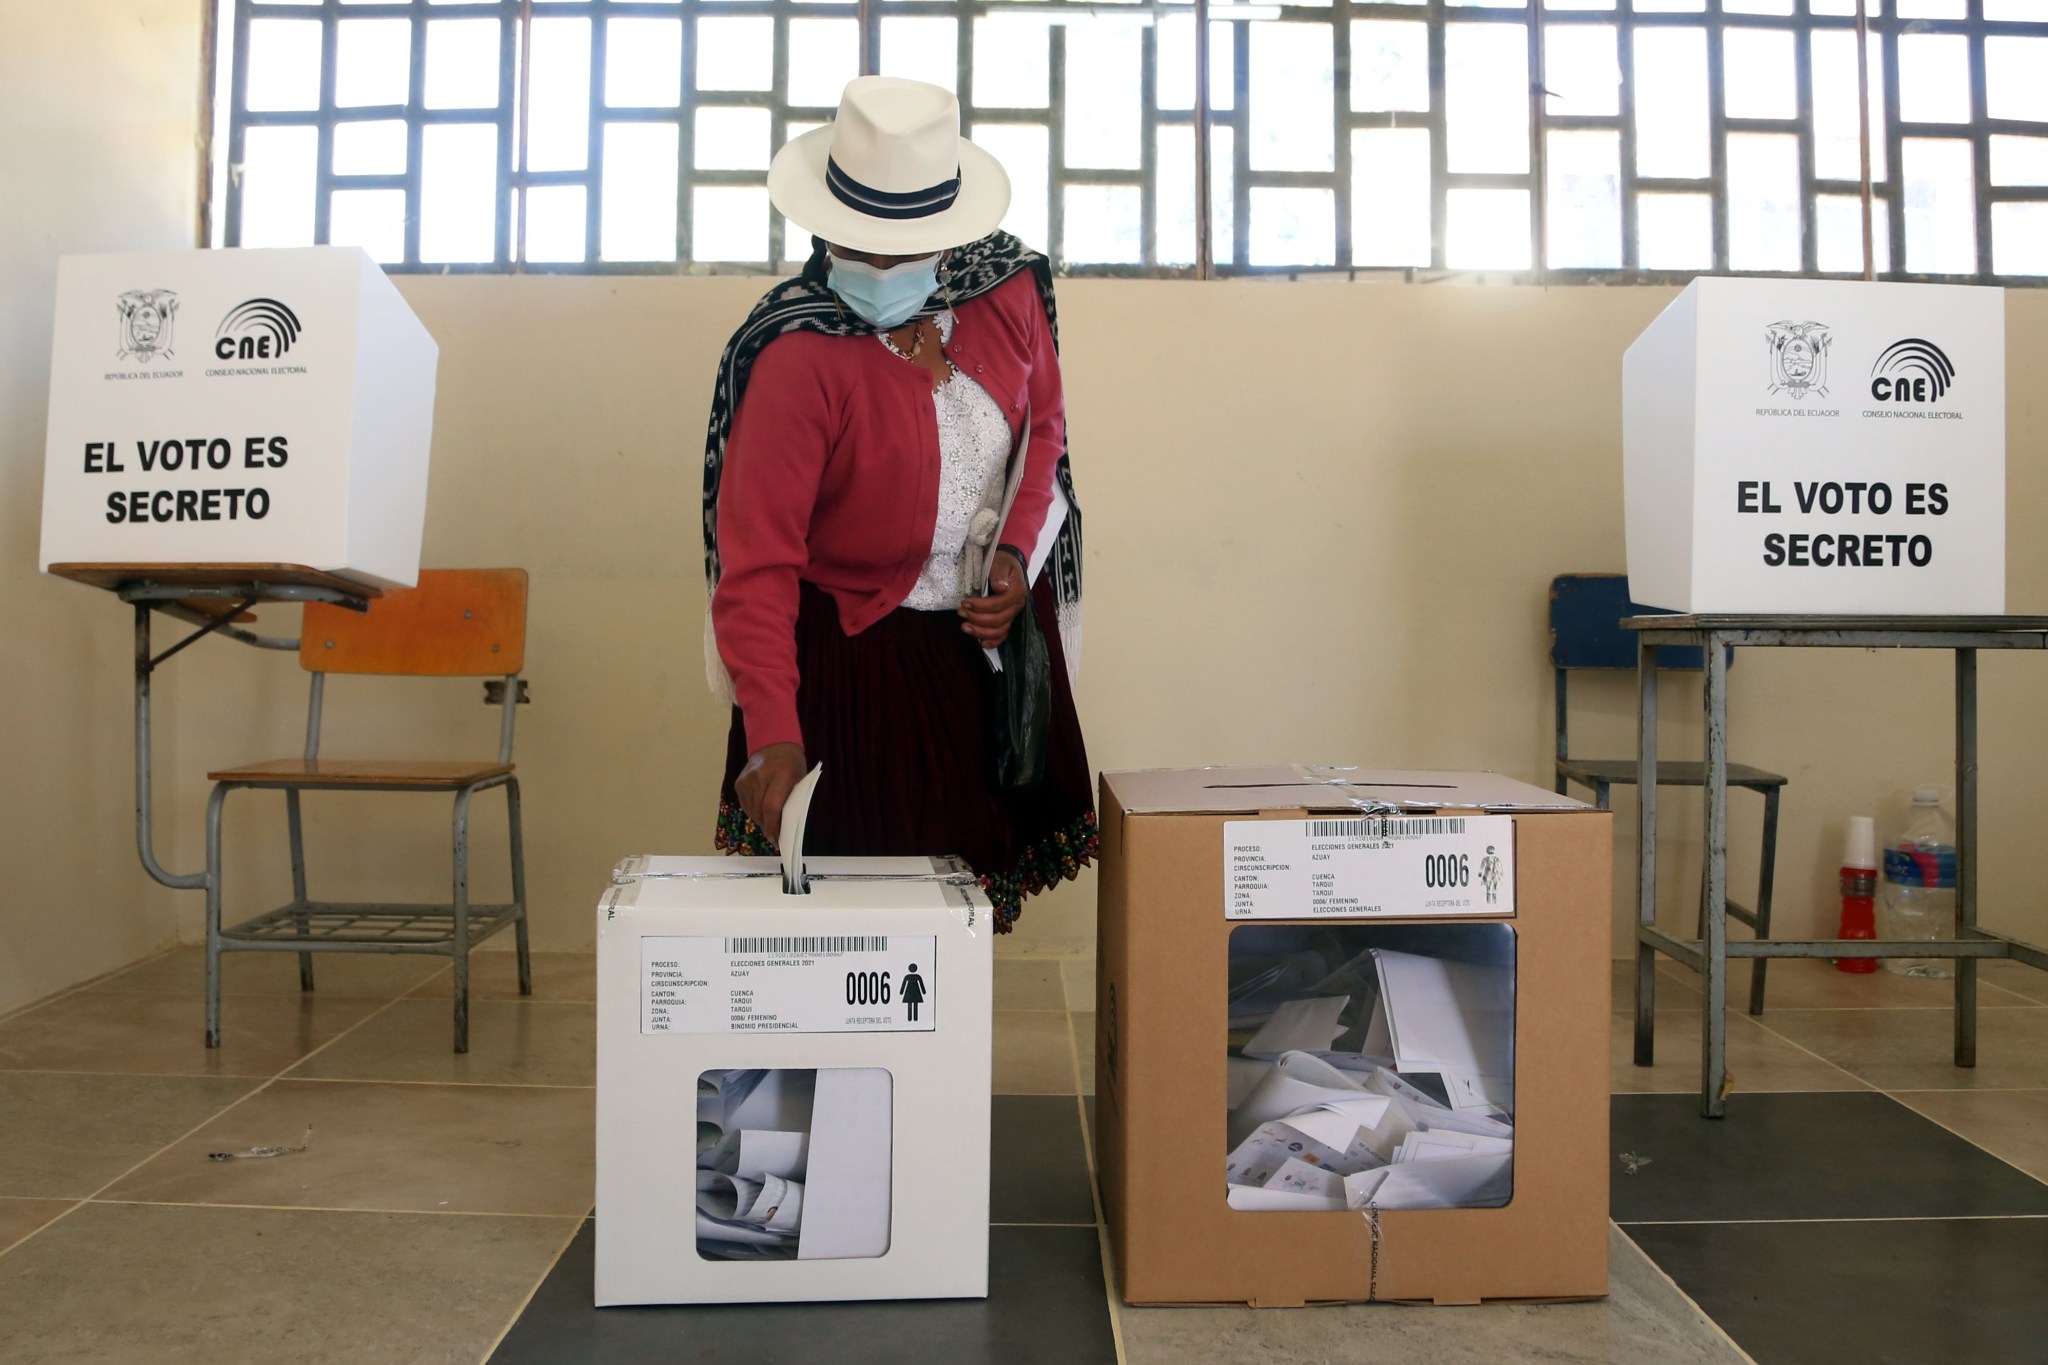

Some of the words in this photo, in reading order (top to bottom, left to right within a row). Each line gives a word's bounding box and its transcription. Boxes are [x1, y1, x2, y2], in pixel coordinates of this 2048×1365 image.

[105, 372, 138, 380] REPÚBLICA
[140, 372, 151, 380] DEL
[205, 368, 234, 377] CONSEJO
[236, 368, 269, 376] NACIONAL
[271, 366, 307, 375] ELECTORAL
[1756, 408, 1791, 416] REPÚBLICA
[1807, 409, 1839, 417] ECUADOR
[1863, 411, 1891, 419] CONSEJO
[1893, 411, 1926, 419] NACIONAL
[1928, 411, 1963, 420] ELECTORAL
[84, 443, 124, 473] EL
[137, 438, 231, 471] VOTO
[245, 437, 288, 468] ES
[106, 488, 269, 523] SECRETO
[1738, 481, 1781, 513] EL
[1794, 482, 1892, 514] VOTO
[1906, 483, 1948, 515] ES
[1764, 533, 1932, 567] SECRETO
[1426, 854, 1469, 888] 0006
[846, 972, 890, 1005] 0006
